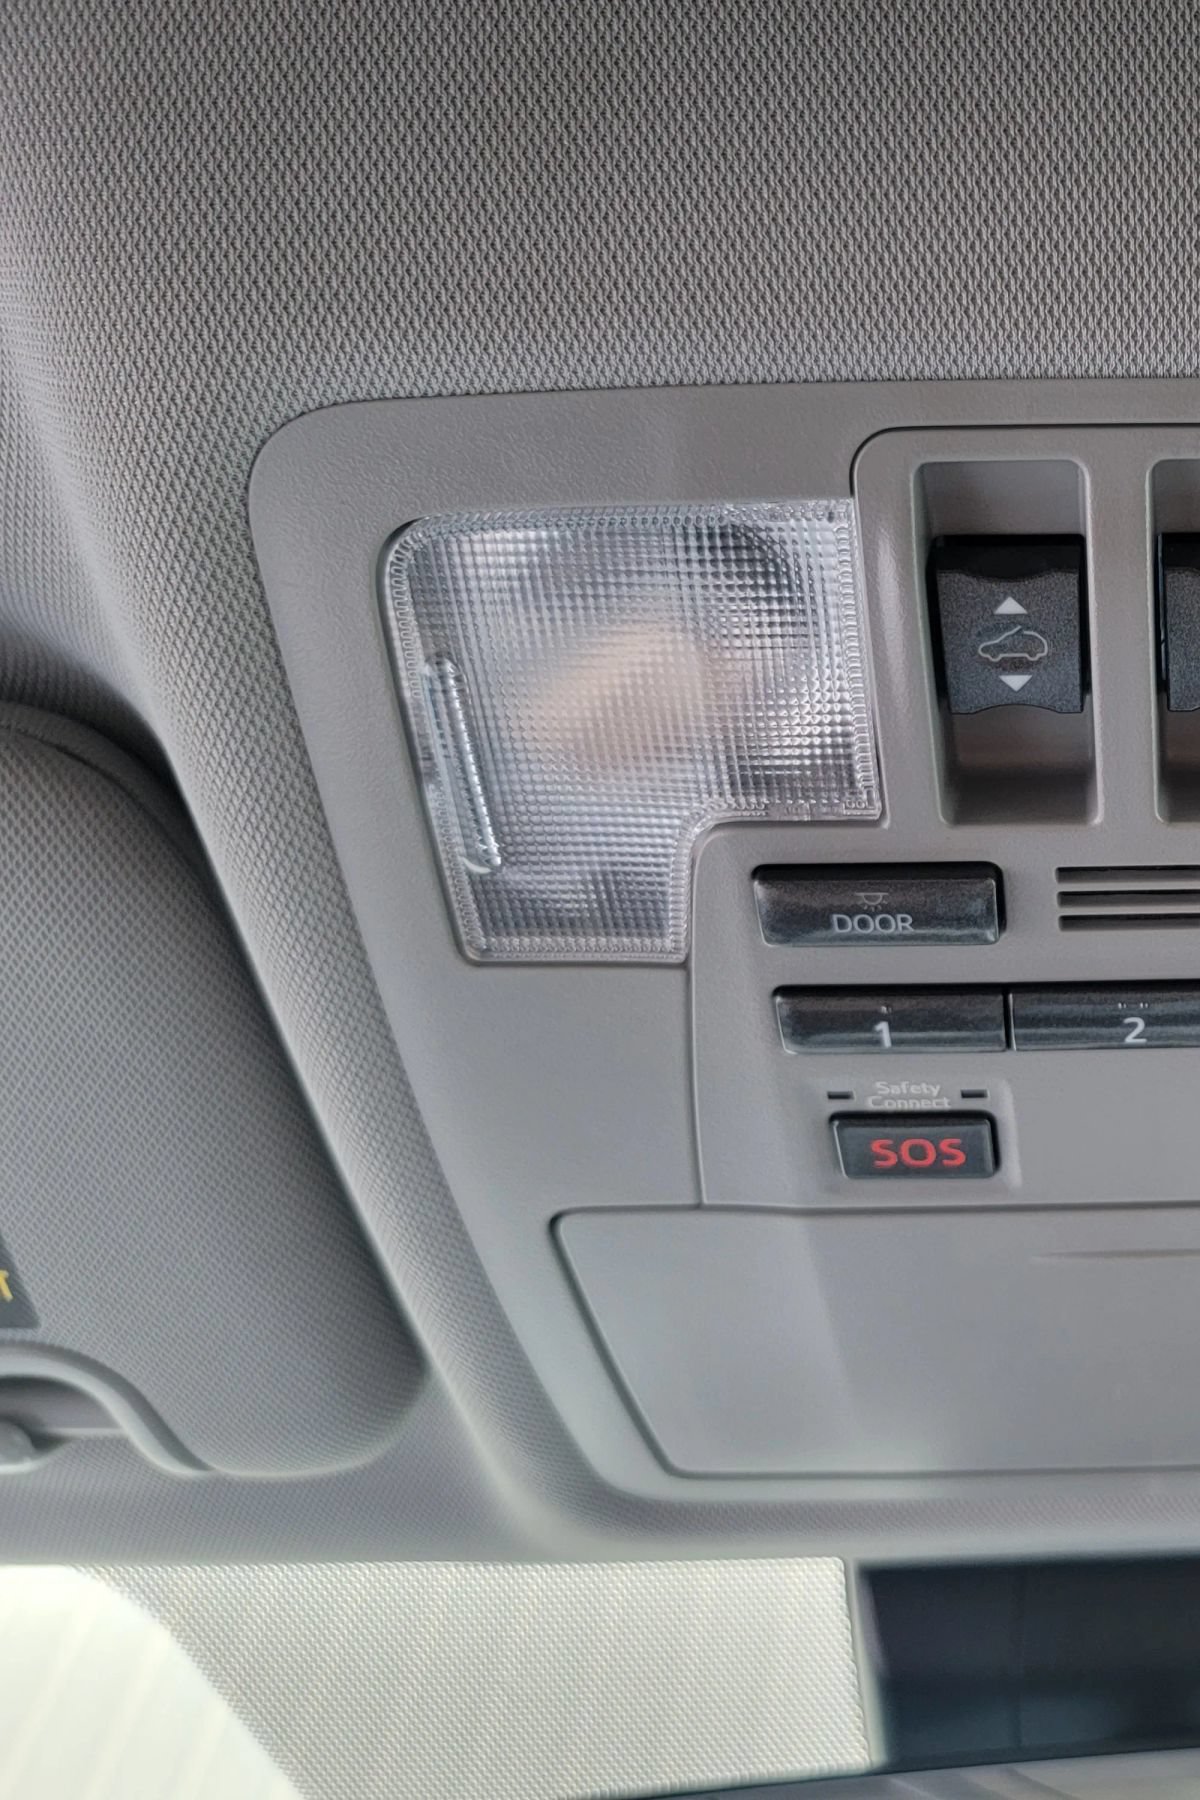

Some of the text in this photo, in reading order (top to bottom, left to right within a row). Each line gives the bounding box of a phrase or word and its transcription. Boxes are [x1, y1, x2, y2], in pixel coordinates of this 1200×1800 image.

[832, 913, 915, 933] DOOR
[872, 1020, 892, 1048] 1
[1123, 1017, 1147, 1043] 2
[875, 1081, 941, 1096] Safety
[868, 1095, 951, 1109] Connect
[871, 1138, 967, 1168] SOS
